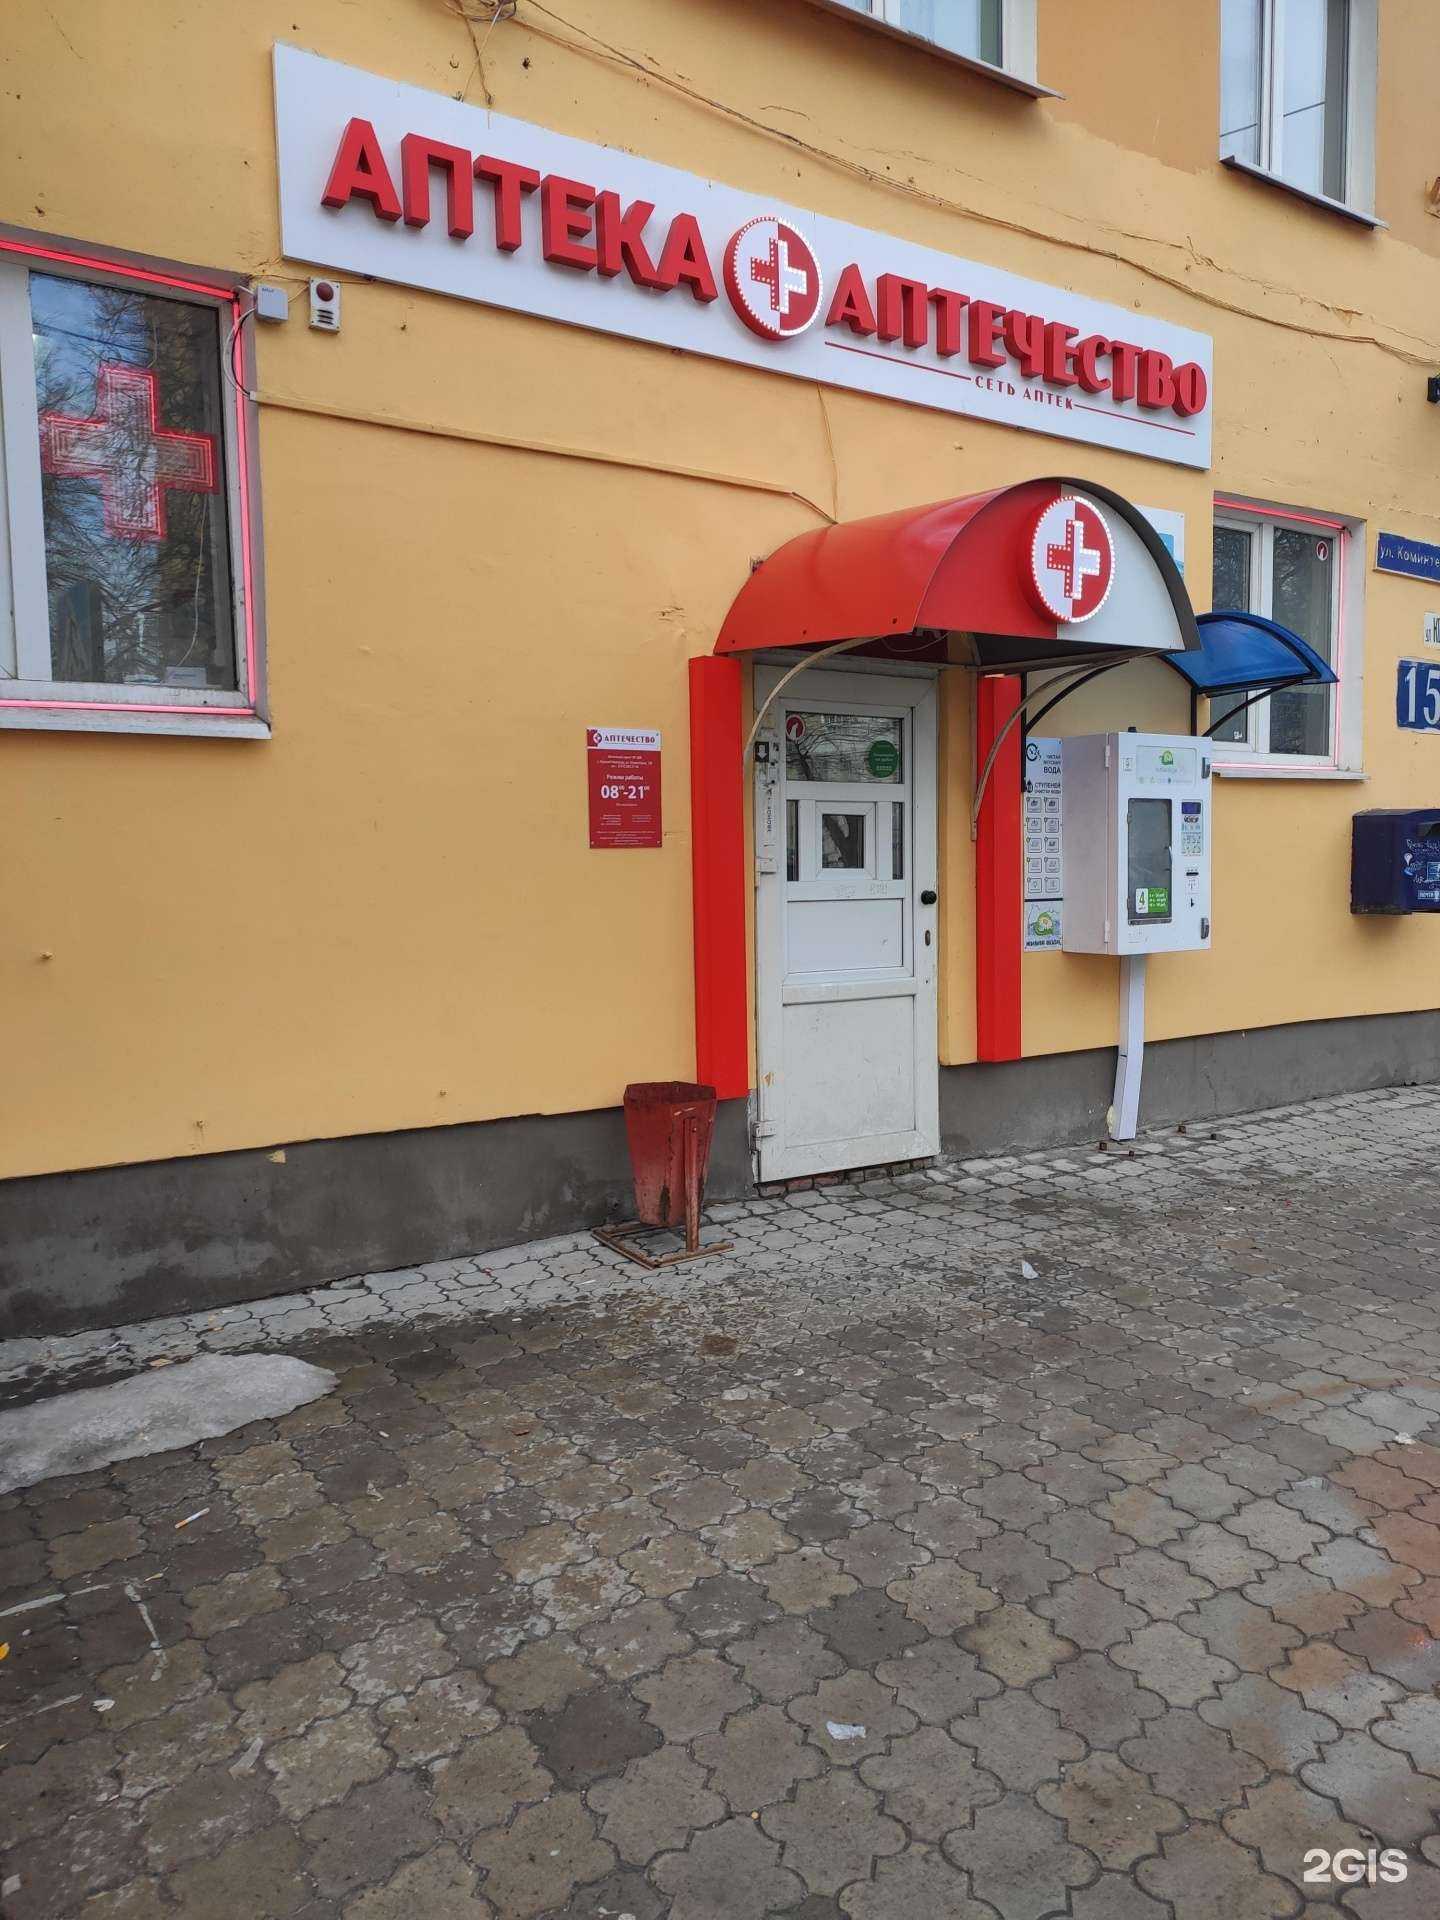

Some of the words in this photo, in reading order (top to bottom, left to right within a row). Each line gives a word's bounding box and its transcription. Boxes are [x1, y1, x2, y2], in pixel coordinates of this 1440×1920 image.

[321, 116, 717, 303] АПТЕКА
[825, 262, 1207, 418] АПТЕЧЕСТВО
[975, 375, 1016, 396] СЕТЬ
[1023, 388, 1074, 411] АПТЕК
[604, 734, 655, 743] АПТЕЧЕСТВО
[1043, 766, 1061, 774] ВОДА
